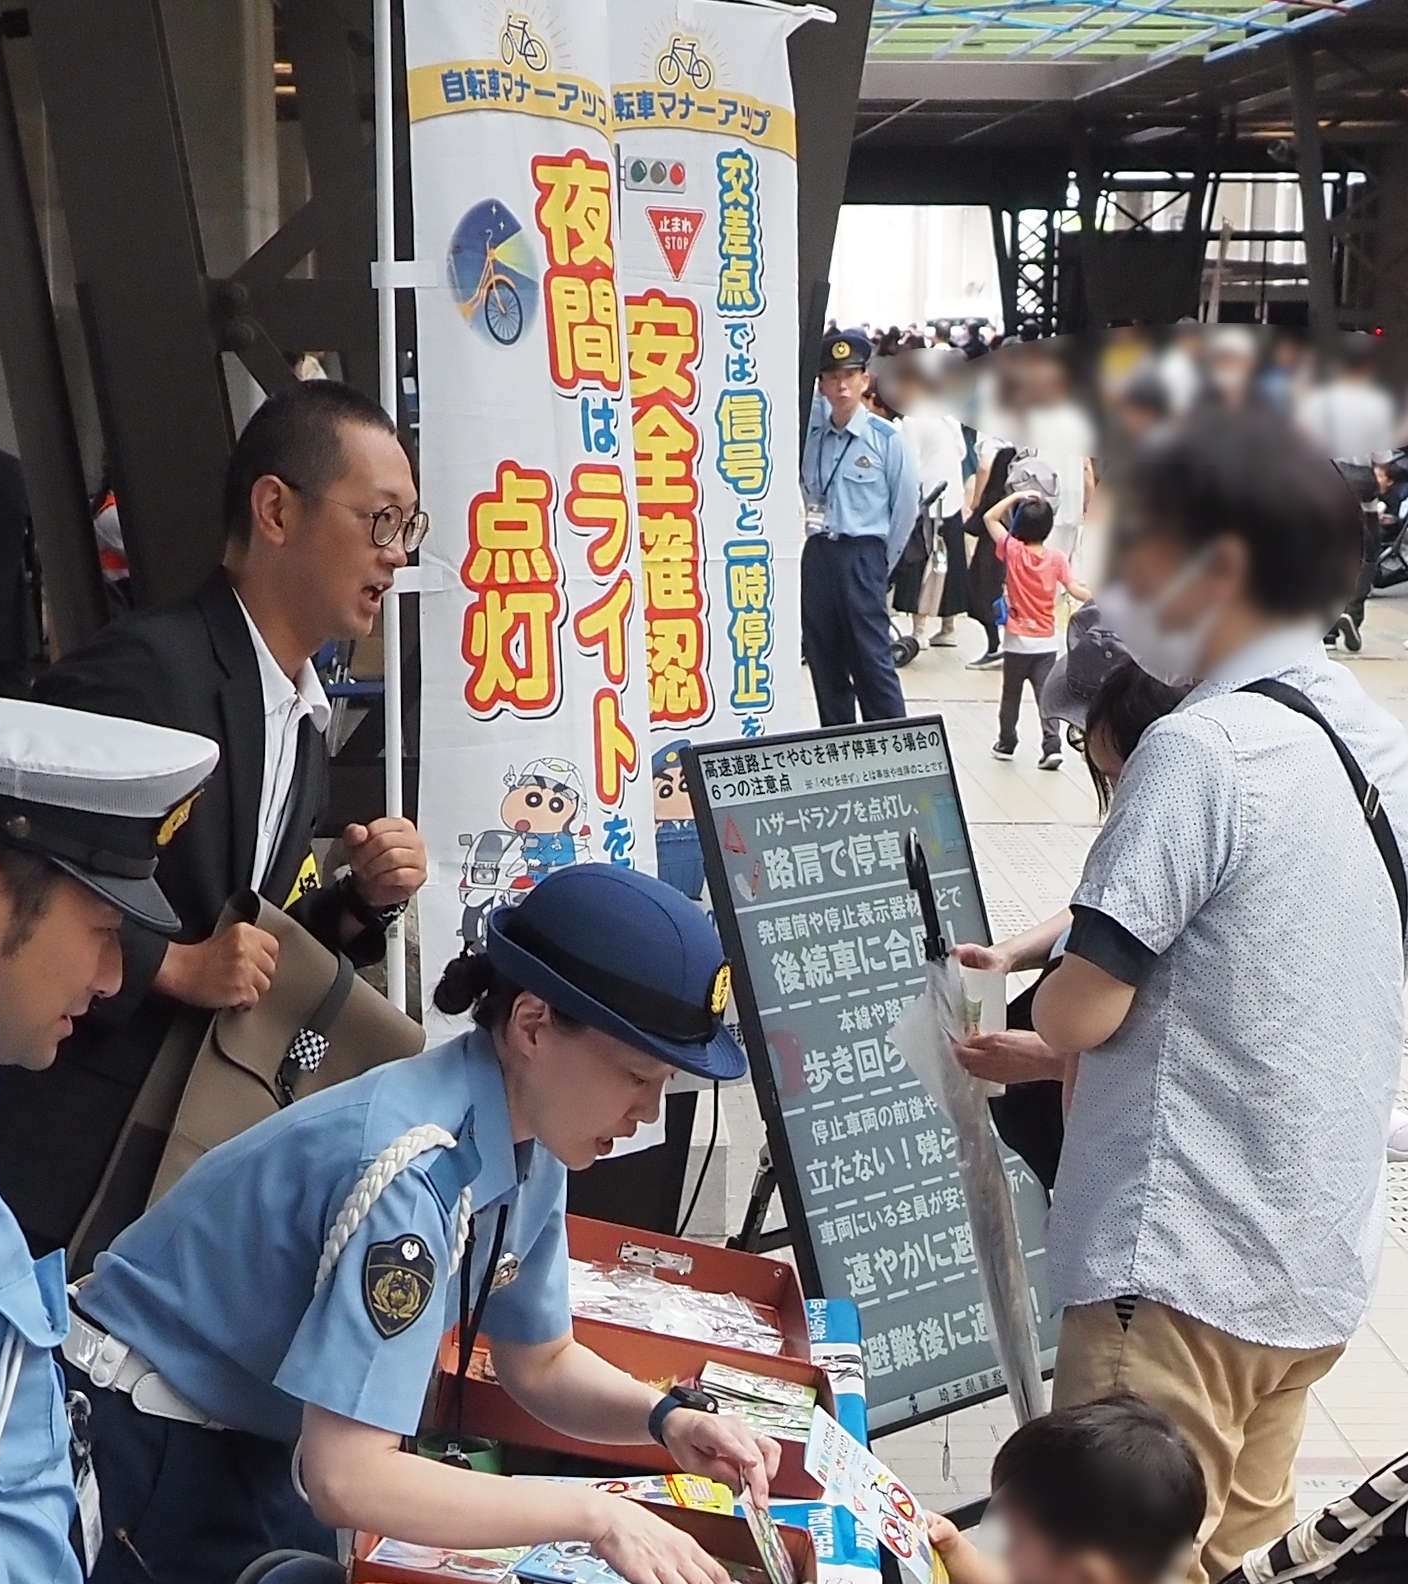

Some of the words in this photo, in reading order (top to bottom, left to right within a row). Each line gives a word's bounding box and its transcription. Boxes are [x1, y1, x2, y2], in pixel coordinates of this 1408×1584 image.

[658, 216, 694, 234] 止まれ
[664, 236, 690, 251] STOP
[461, 460, 563, 712] 点灯
[703, 731, 941, 781] 高速道路上でやむを得ず停車する場合の
[755, 794, 920, 837] ハザードランプを点灯し、
[758, 886, 962, 946] 発煙筒や停止表示器材どで
